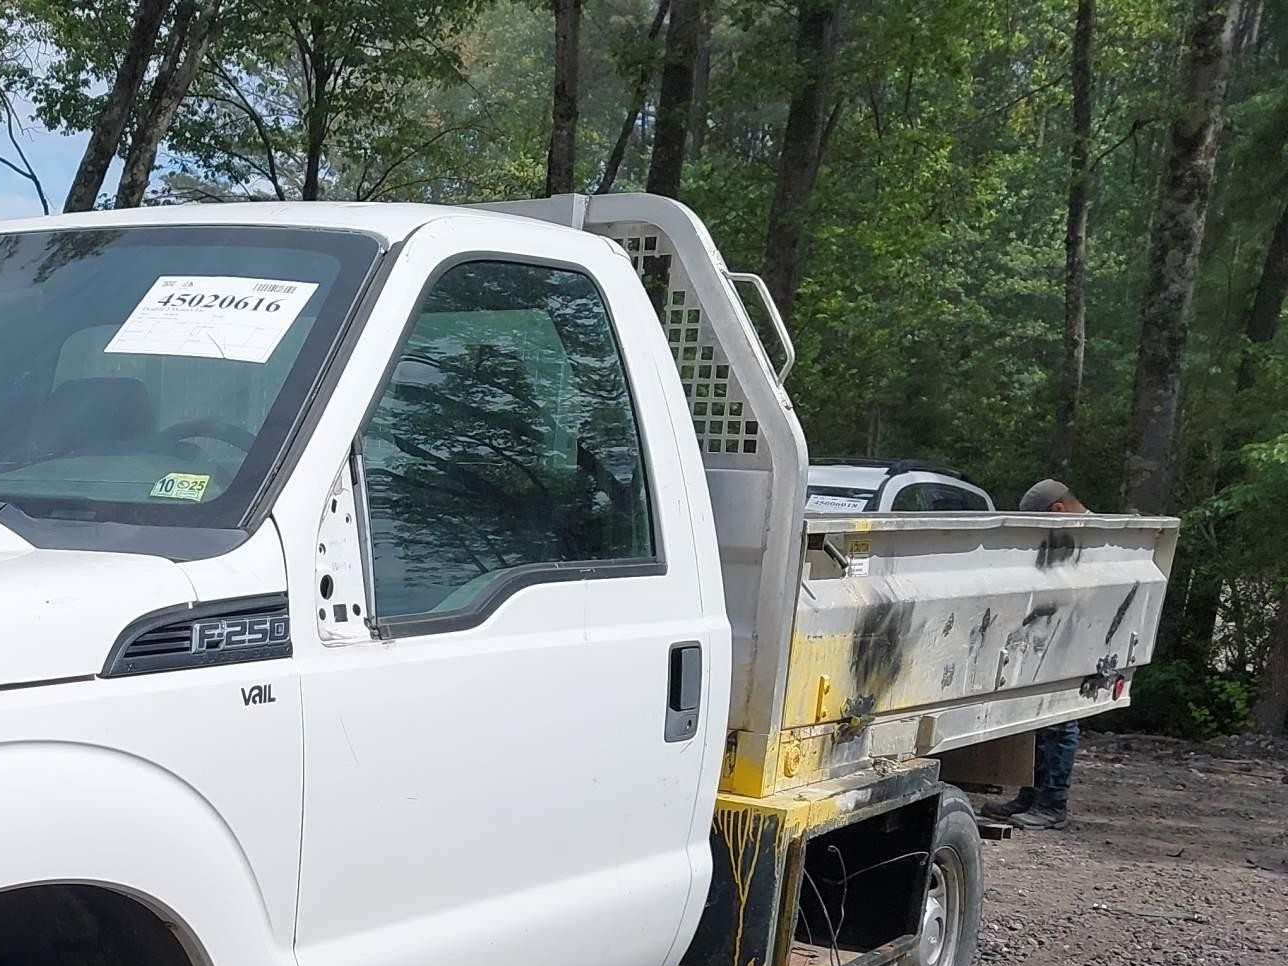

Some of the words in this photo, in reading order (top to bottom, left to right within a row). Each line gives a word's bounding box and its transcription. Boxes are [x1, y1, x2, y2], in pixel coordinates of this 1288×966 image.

[157, 292, 287, 313] 45020616
[158, 478, 175, 493] 10
[188, 480, 206, 492] 25
